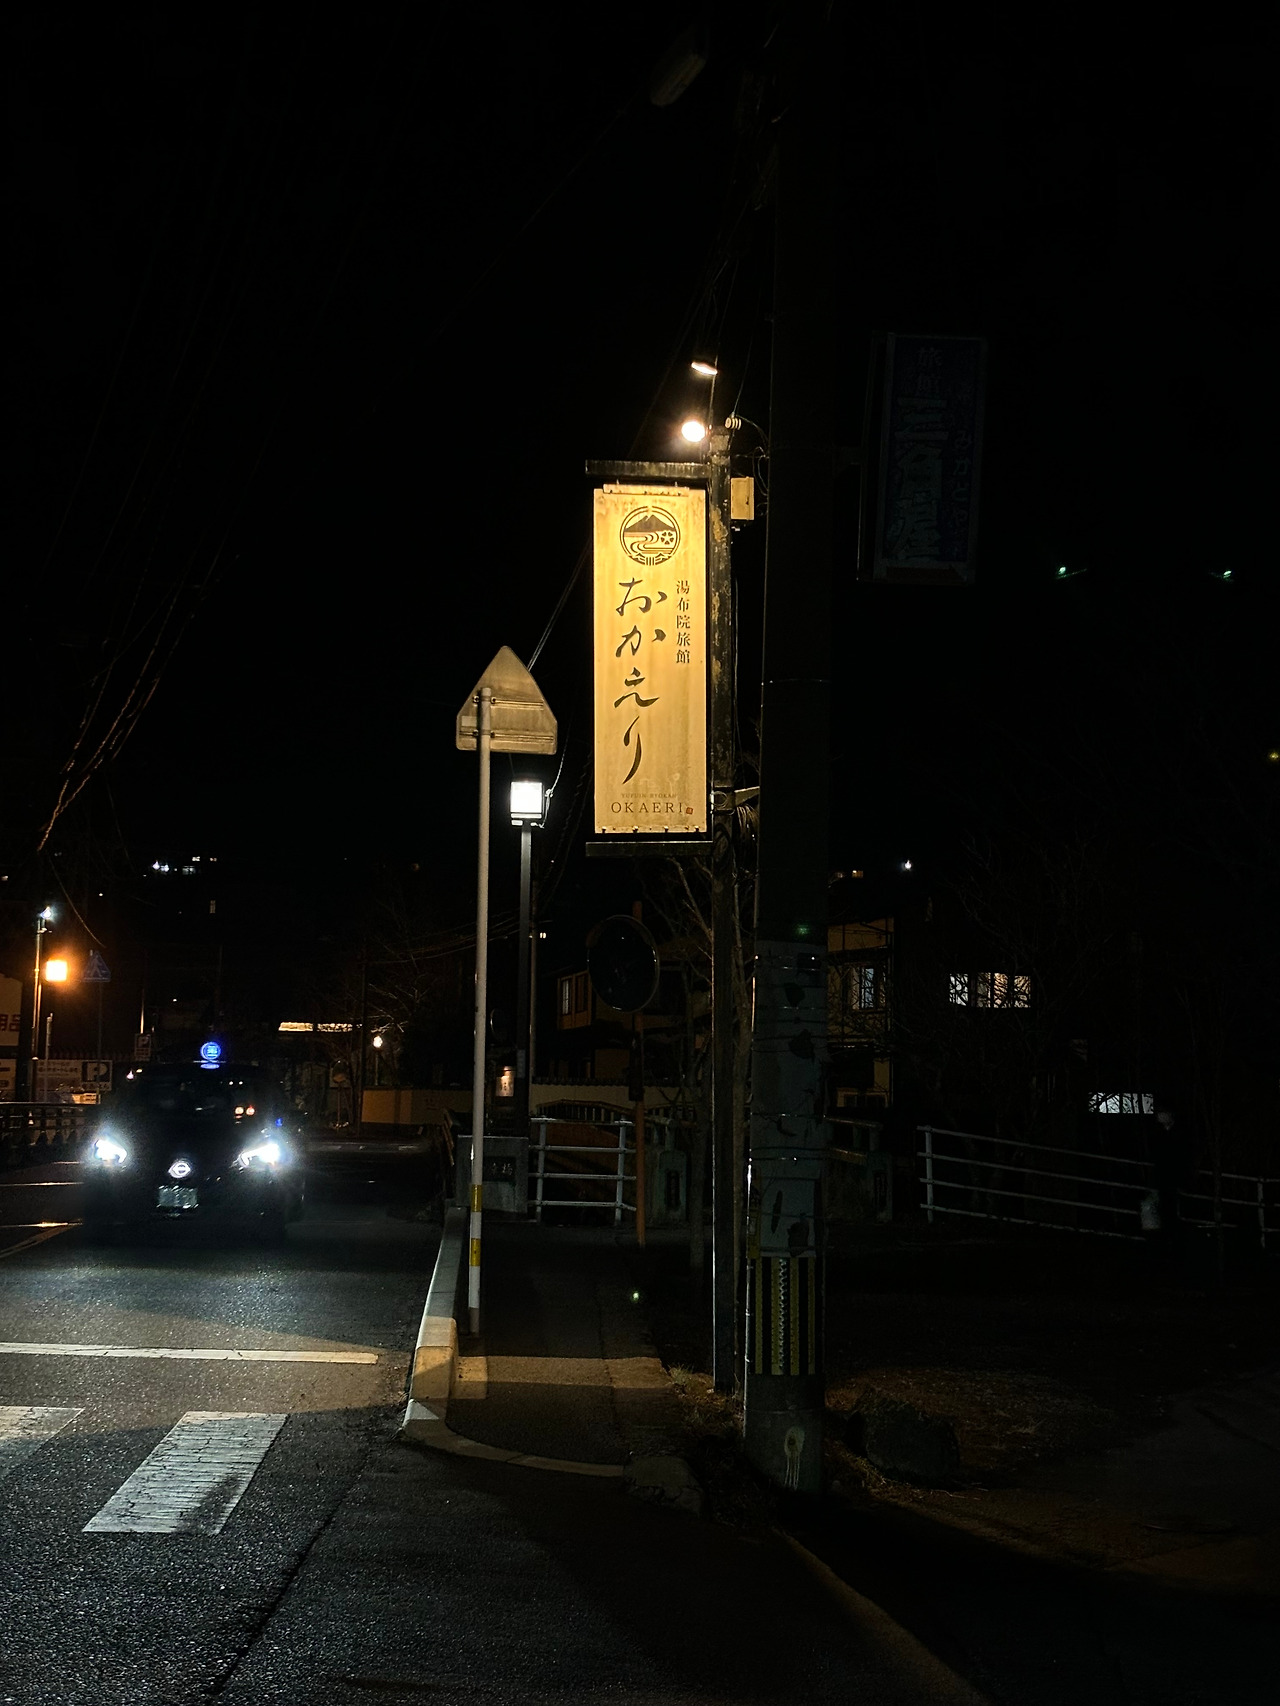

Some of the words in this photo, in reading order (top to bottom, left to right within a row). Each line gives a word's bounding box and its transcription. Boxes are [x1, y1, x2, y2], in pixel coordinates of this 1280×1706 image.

[676, 580, 691, 664] 湯布院旅館
[614, 577, 667, 785] おかえり
[611, 801, 682, 814] OKAERI
[87, 1062, 108, 1081] P
